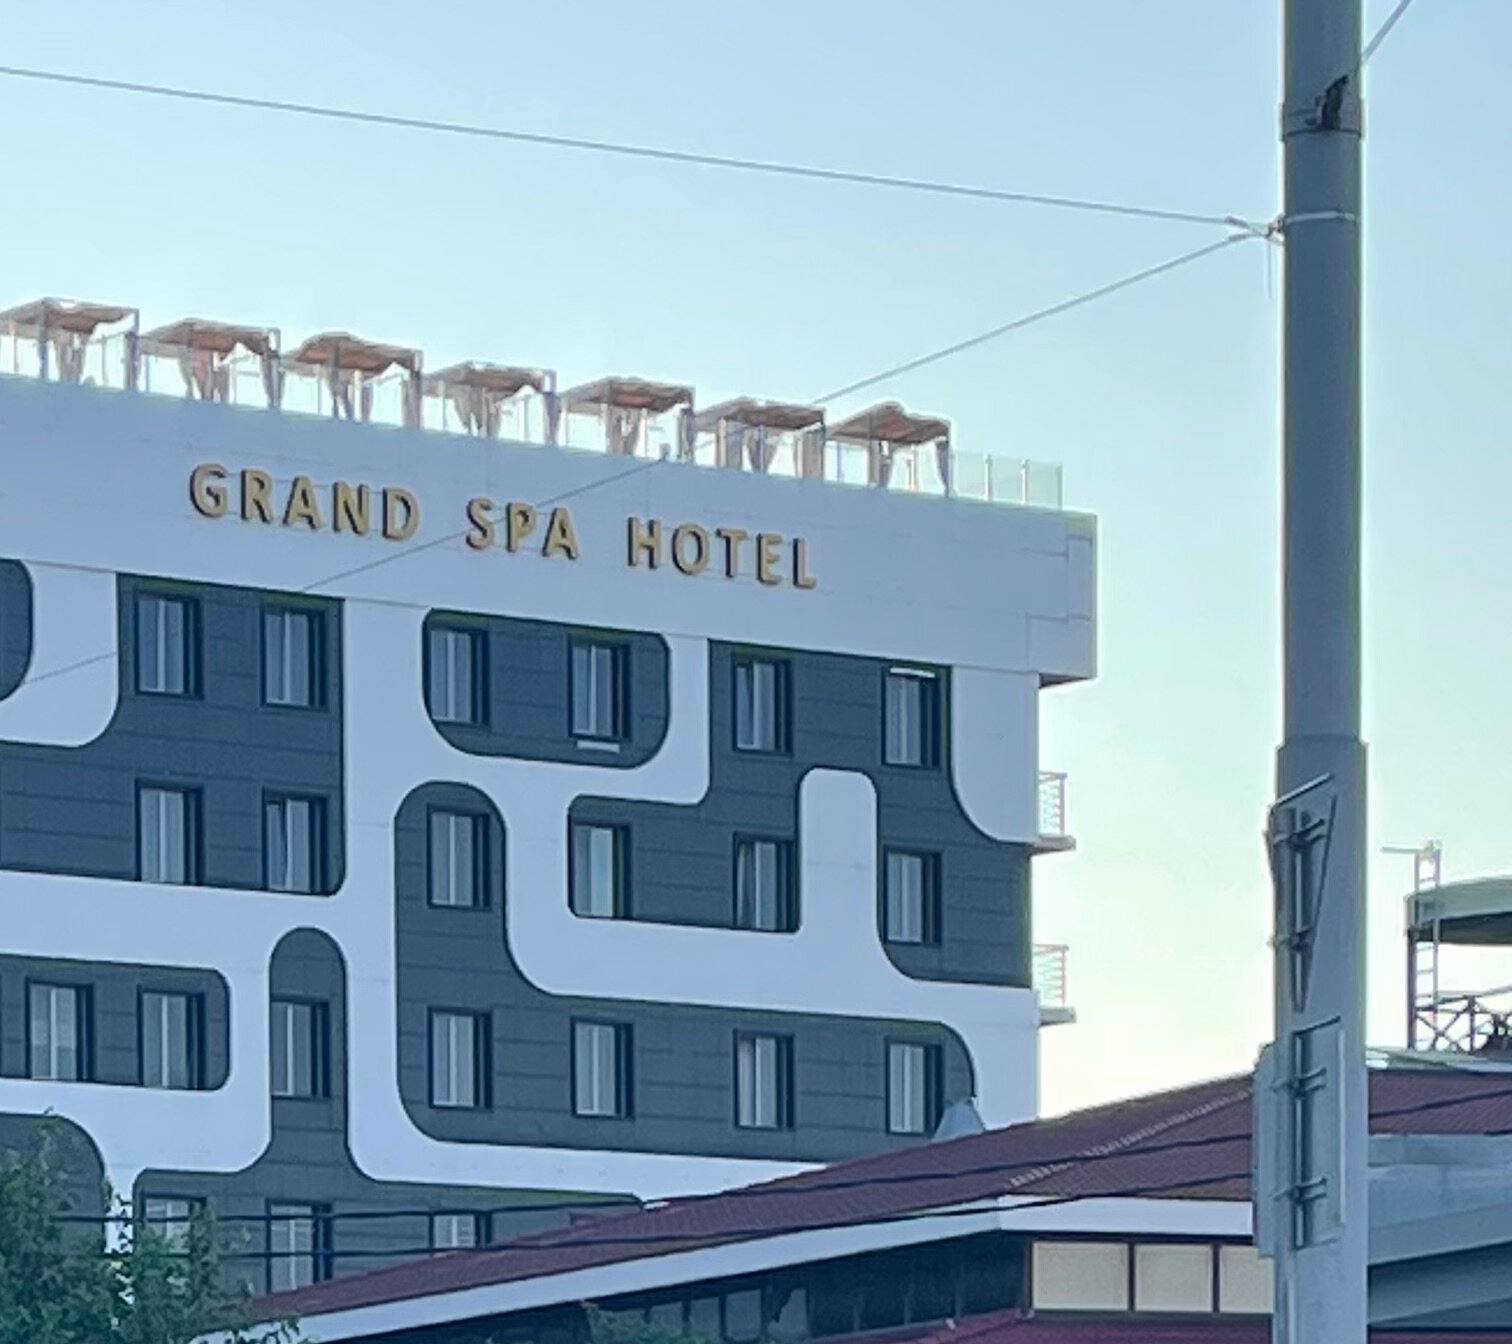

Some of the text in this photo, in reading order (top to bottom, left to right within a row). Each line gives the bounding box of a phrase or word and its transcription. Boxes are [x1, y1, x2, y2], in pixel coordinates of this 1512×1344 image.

[190, 463, 816, 588] GRAND SPA HOTEL
